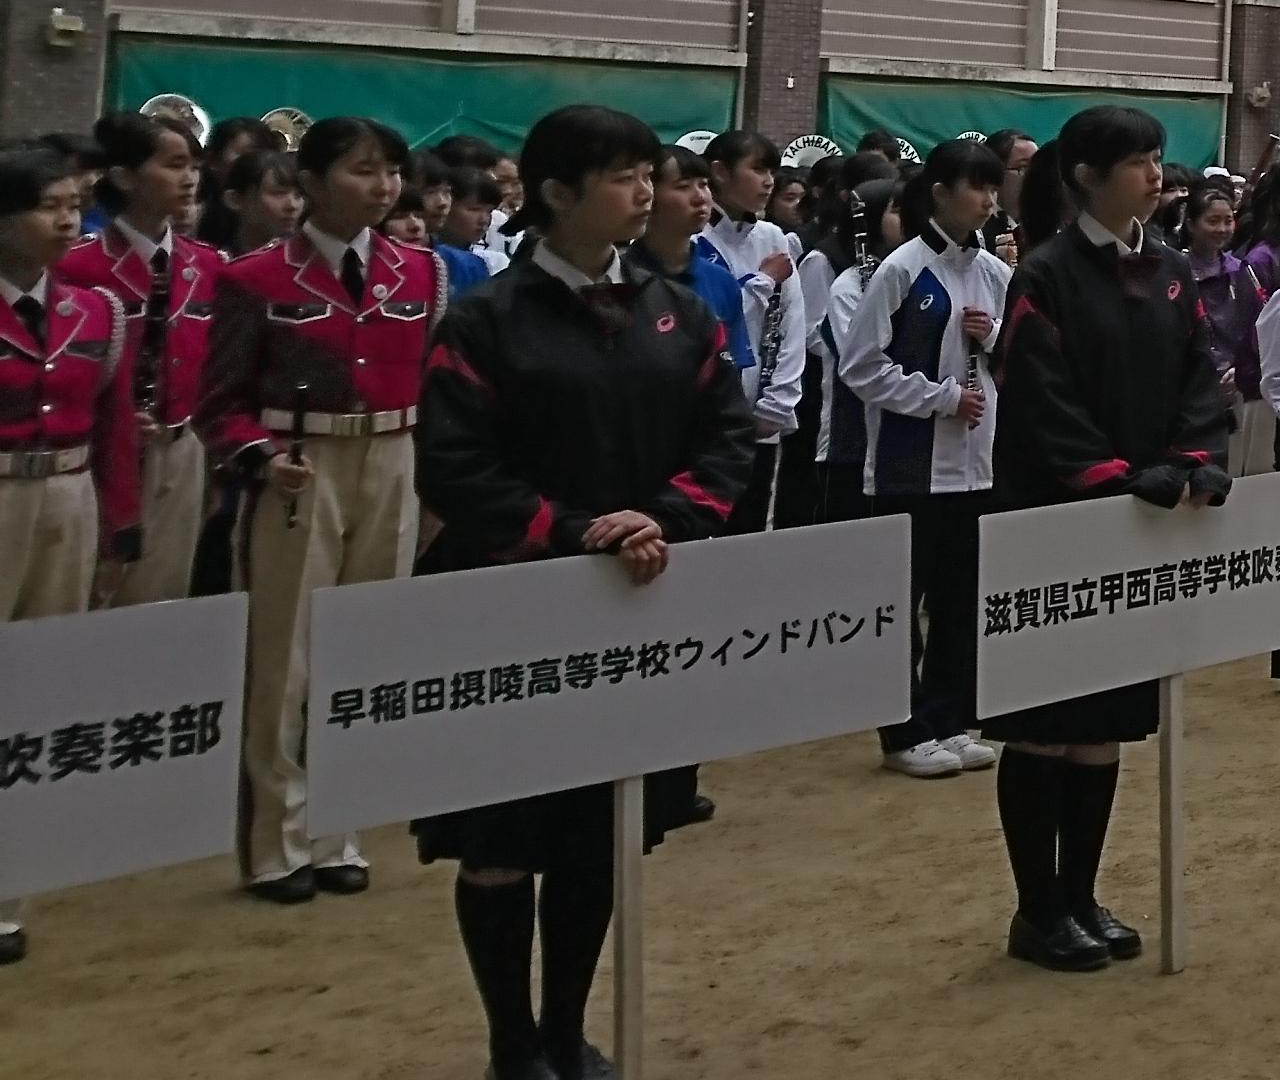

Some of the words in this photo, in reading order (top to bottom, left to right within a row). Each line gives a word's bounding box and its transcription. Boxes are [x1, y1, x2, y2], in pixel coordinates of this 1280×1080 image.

[327, 604, 896, 729] 早稲田摂陵高等学校ウィンドバンド
